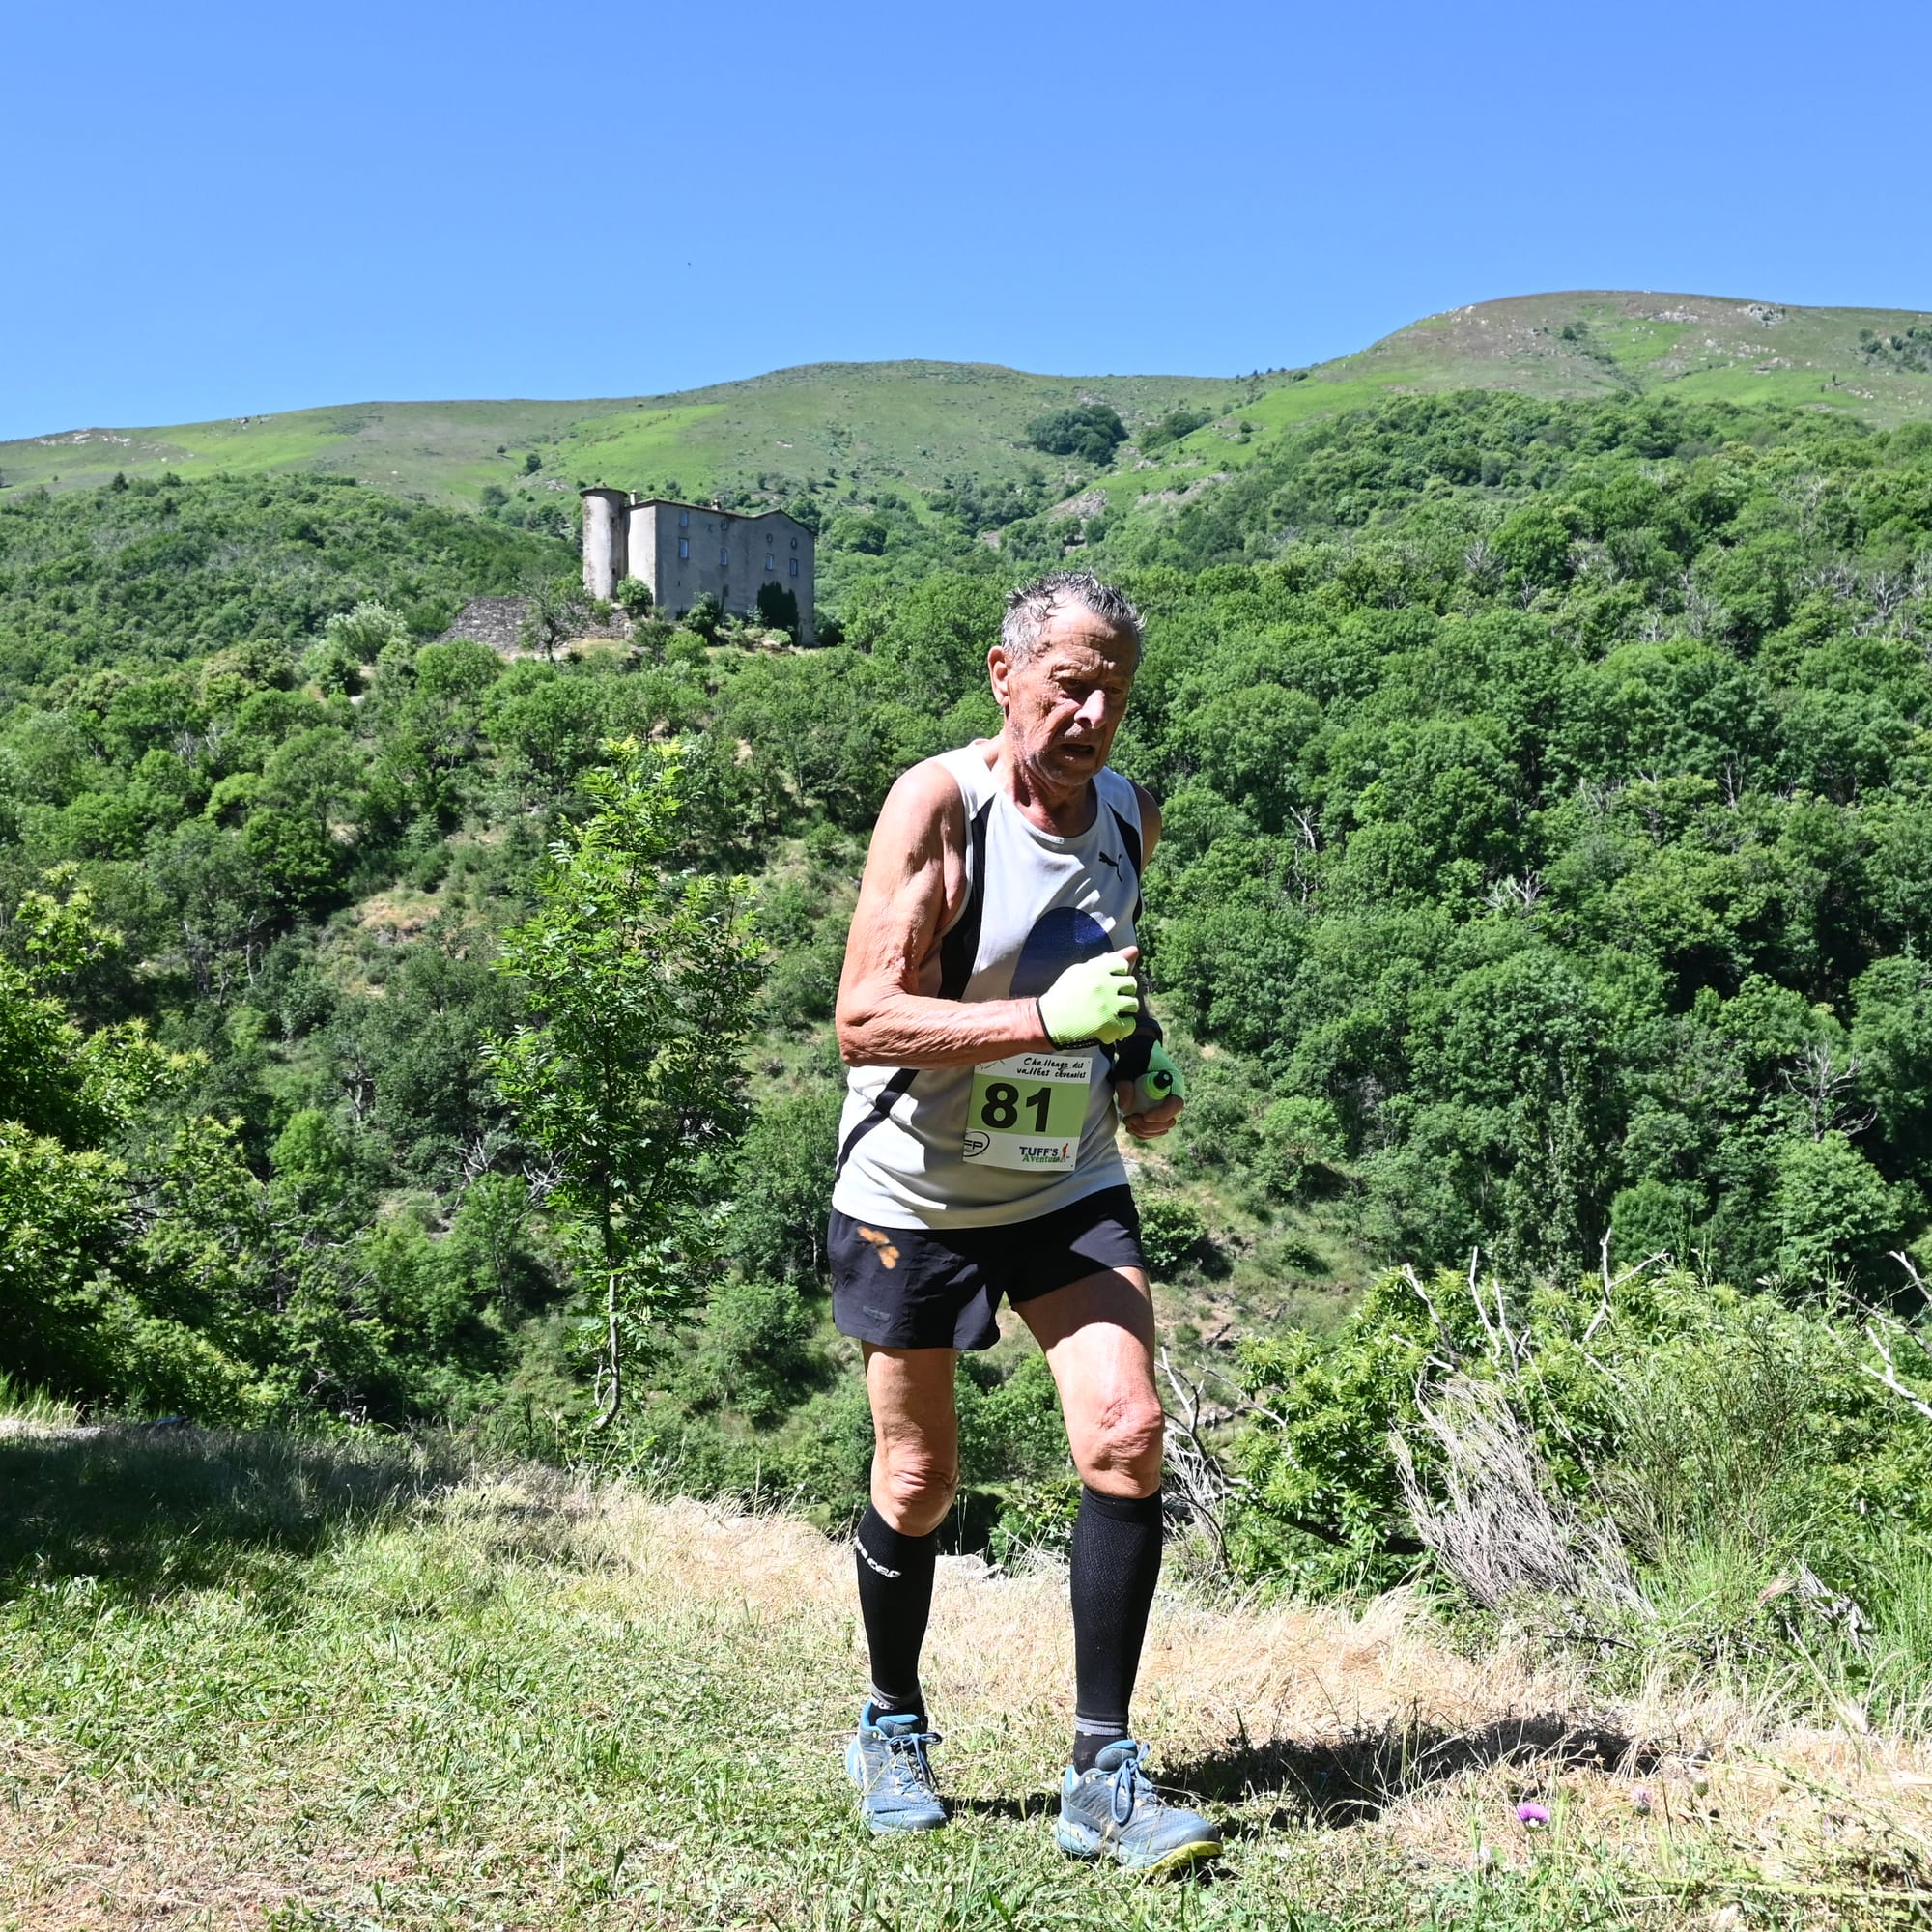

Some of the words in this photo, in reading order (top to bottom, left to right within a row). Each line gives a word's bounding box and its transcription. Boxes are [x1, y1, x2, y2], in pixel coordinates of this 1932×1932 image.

[1023, 1057, 1068, 1070] Challenge
[1072, 1061, 1084, 1069] des
[1017, 1066, 1050, 1077] vallées
[980, 1082, 1052, 1133] 81
[1019, 1146, 1059, 1157] TUFF'S
